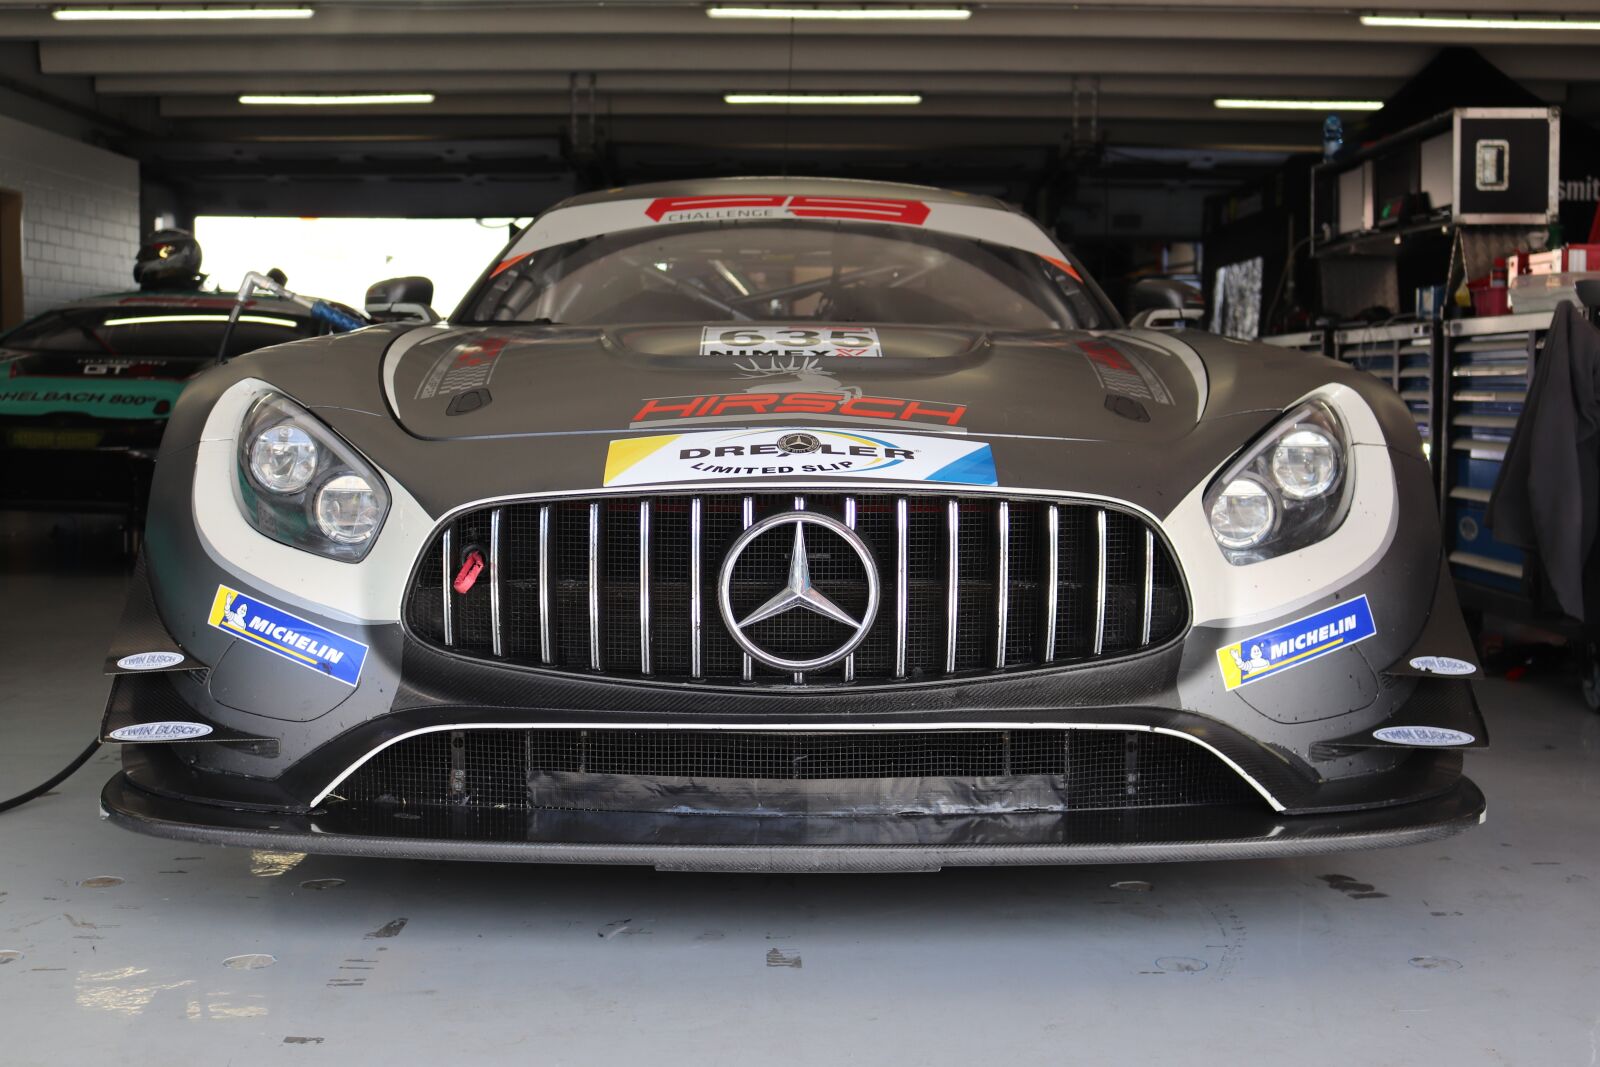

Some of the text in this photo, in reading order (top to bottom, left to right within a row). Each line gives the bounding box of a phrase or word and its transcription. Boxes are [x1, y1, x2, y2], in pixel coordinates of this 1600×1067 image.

[668, 207, 774, 222] CHALLENGE
[720, 330, 874, 347] 635
[0, 392, 105, 402] HELBACH
[633, 393, 967, 425] HIRSCH
[679, 442, 915, 460] DRELER
[690, 459, 854, 475] LIMITED SLIP
[248, 615, 345, 664] MICHELIN
[1270, 614, 1357, 660] MICHELIN
[124, 654, 177, 666] TWIN BUSCH
[1416, 658, 1437, 668] TWIN
[120, 724, 201, 737] TWIN BUSCH
[1381, 729, 1463, 741] TWIN BUSCH
